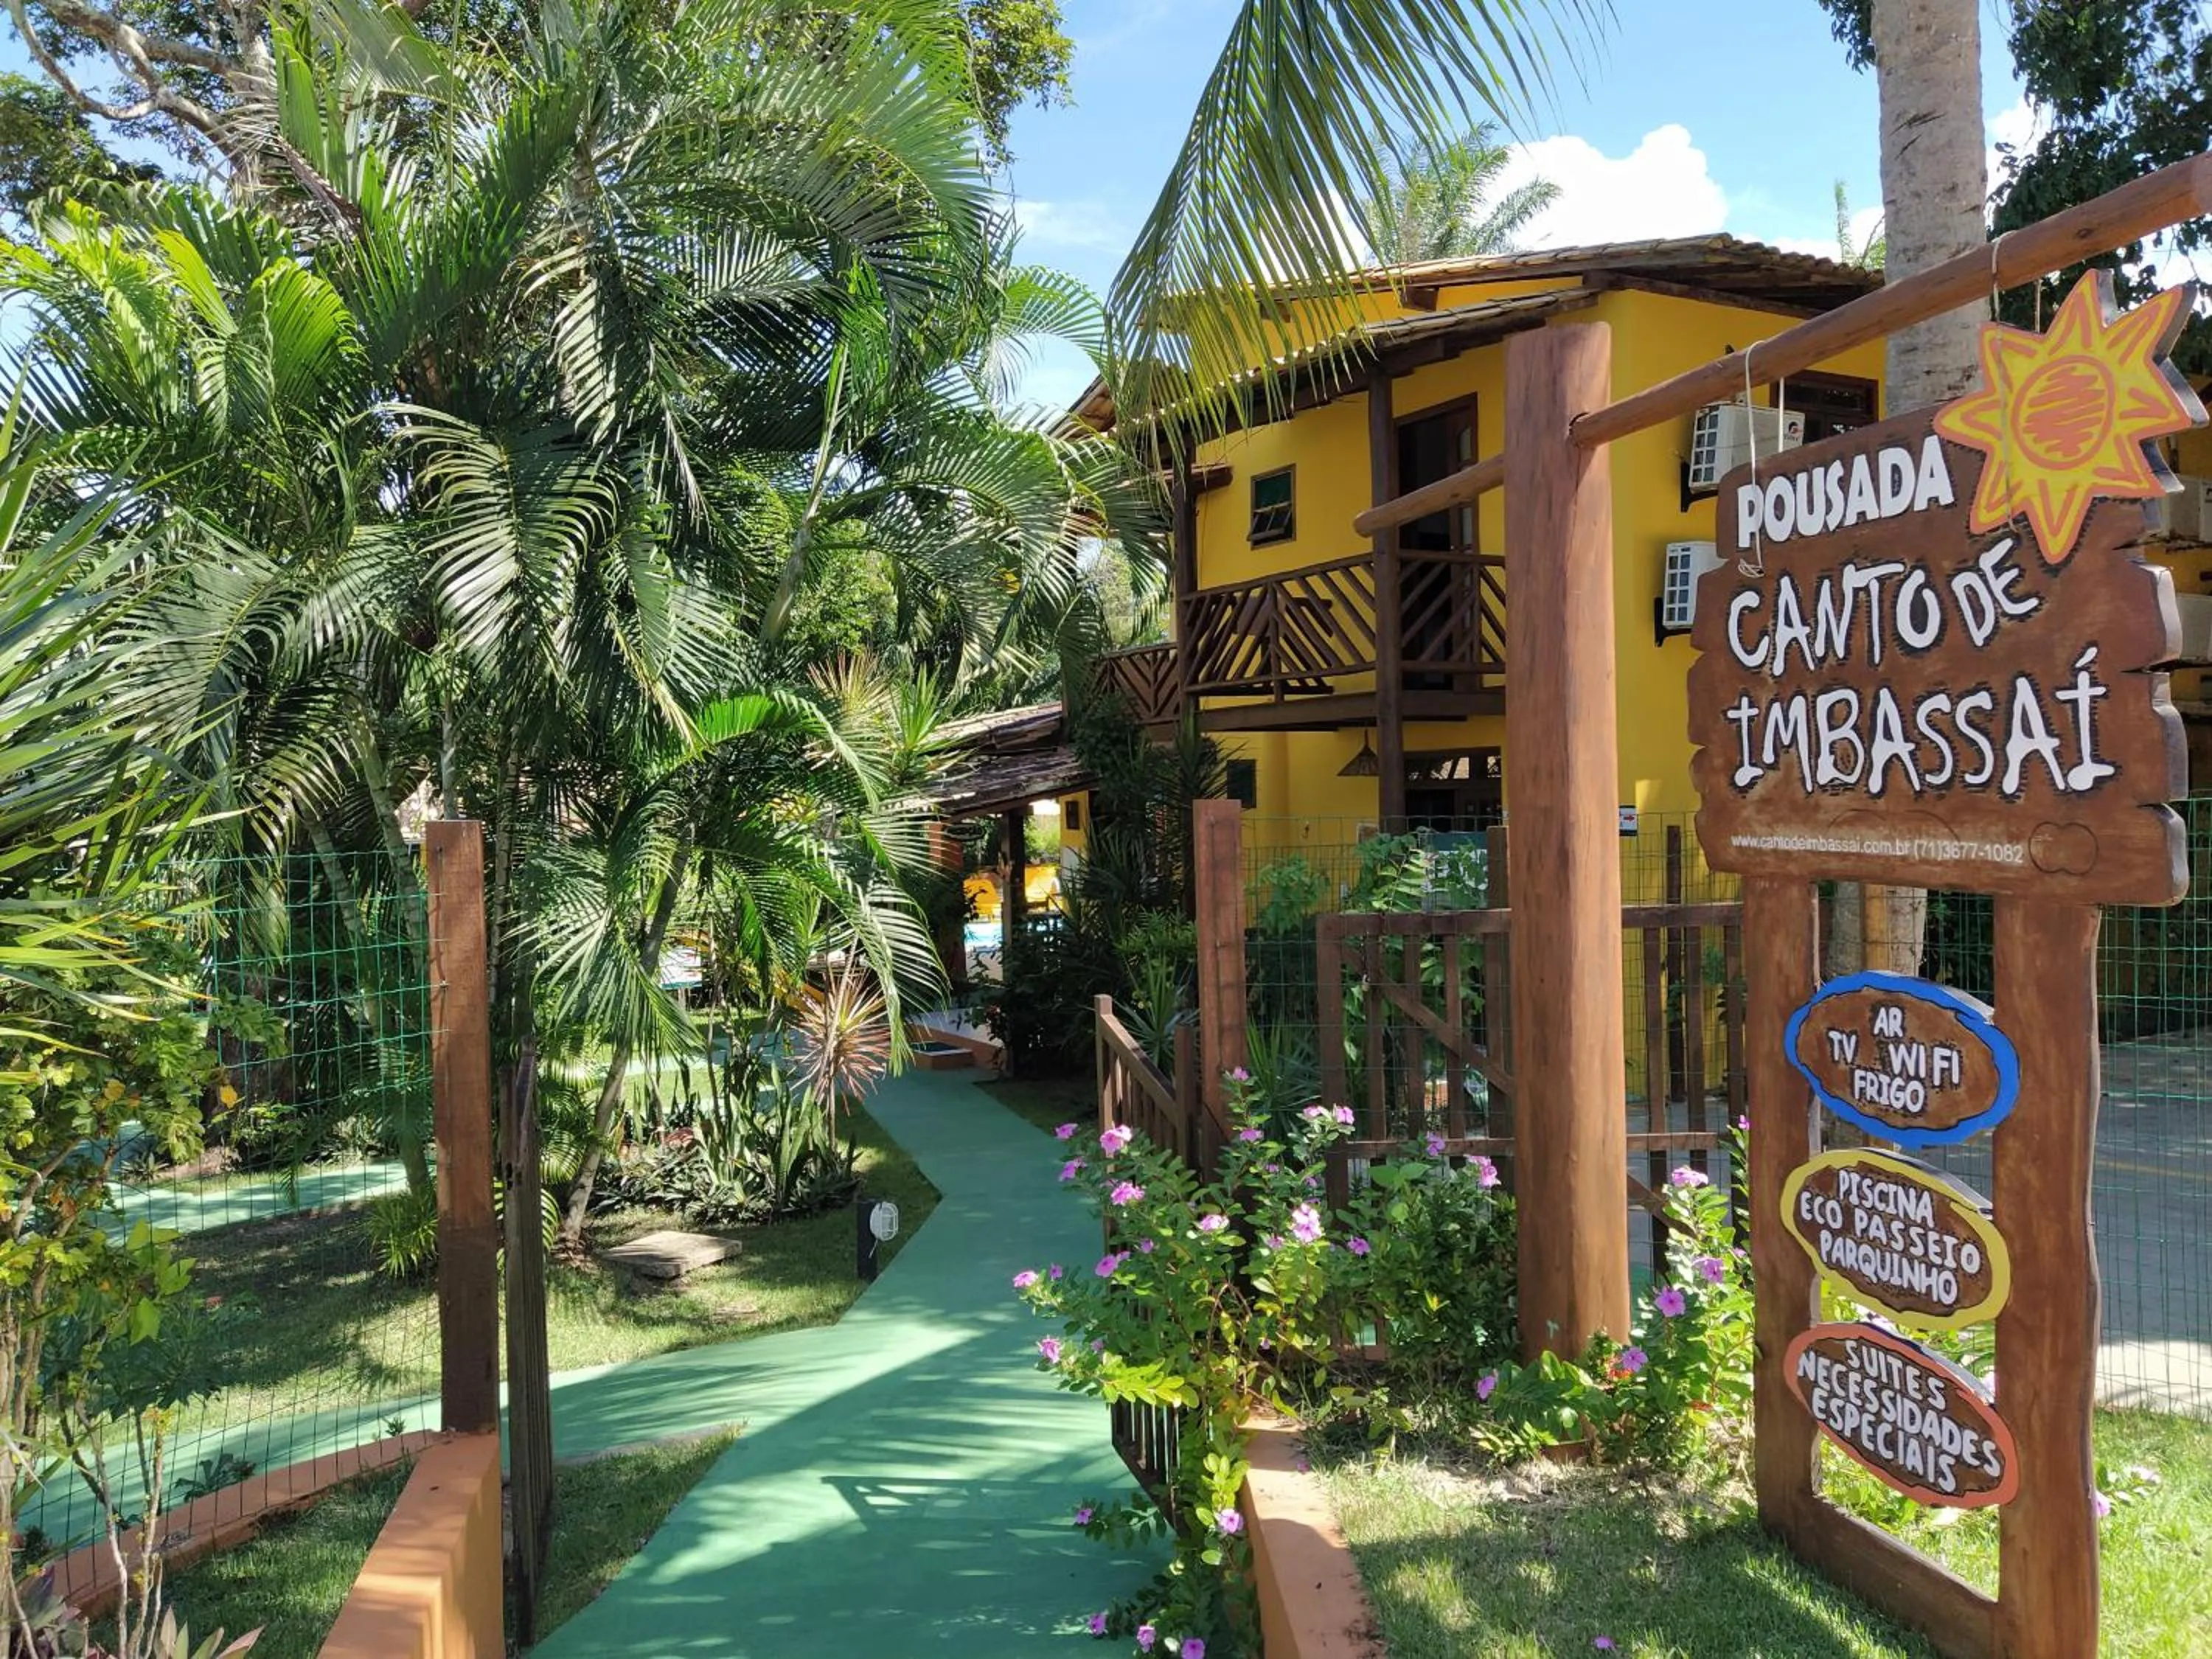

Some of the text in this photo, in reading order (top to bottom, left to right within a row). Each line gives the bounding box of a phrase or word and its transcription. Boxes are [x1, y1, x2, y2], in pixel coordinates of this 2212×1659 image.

[1737, 436, 1954, 548] POUSADA
[1729, 538, 2038, 675] CANTO DE
[1727, 647, 2115, 794] IMBASSAÍ
[1731, 835, 1910, 855] www.cantodeimbassai.com.br
[1829, 1031, 1857, 1063] TV
[1874, 1007, 1903, 1037] AR
[1854, 1069, 1926, 1113] FRIGO
[1801, 1191, 1980, 1274] ECO PASSEIO
[1838, 1169, 1935, 1228] PISCINA
[1820, 1230, 1958, 1305] PARQUINHO
[1846, 1340, 1947, 1411] SUITES
[1798, 1351, 2000, 1478] NECESSIDADES
[1812, 1387, 1956, 1492] ESPECIAIS
